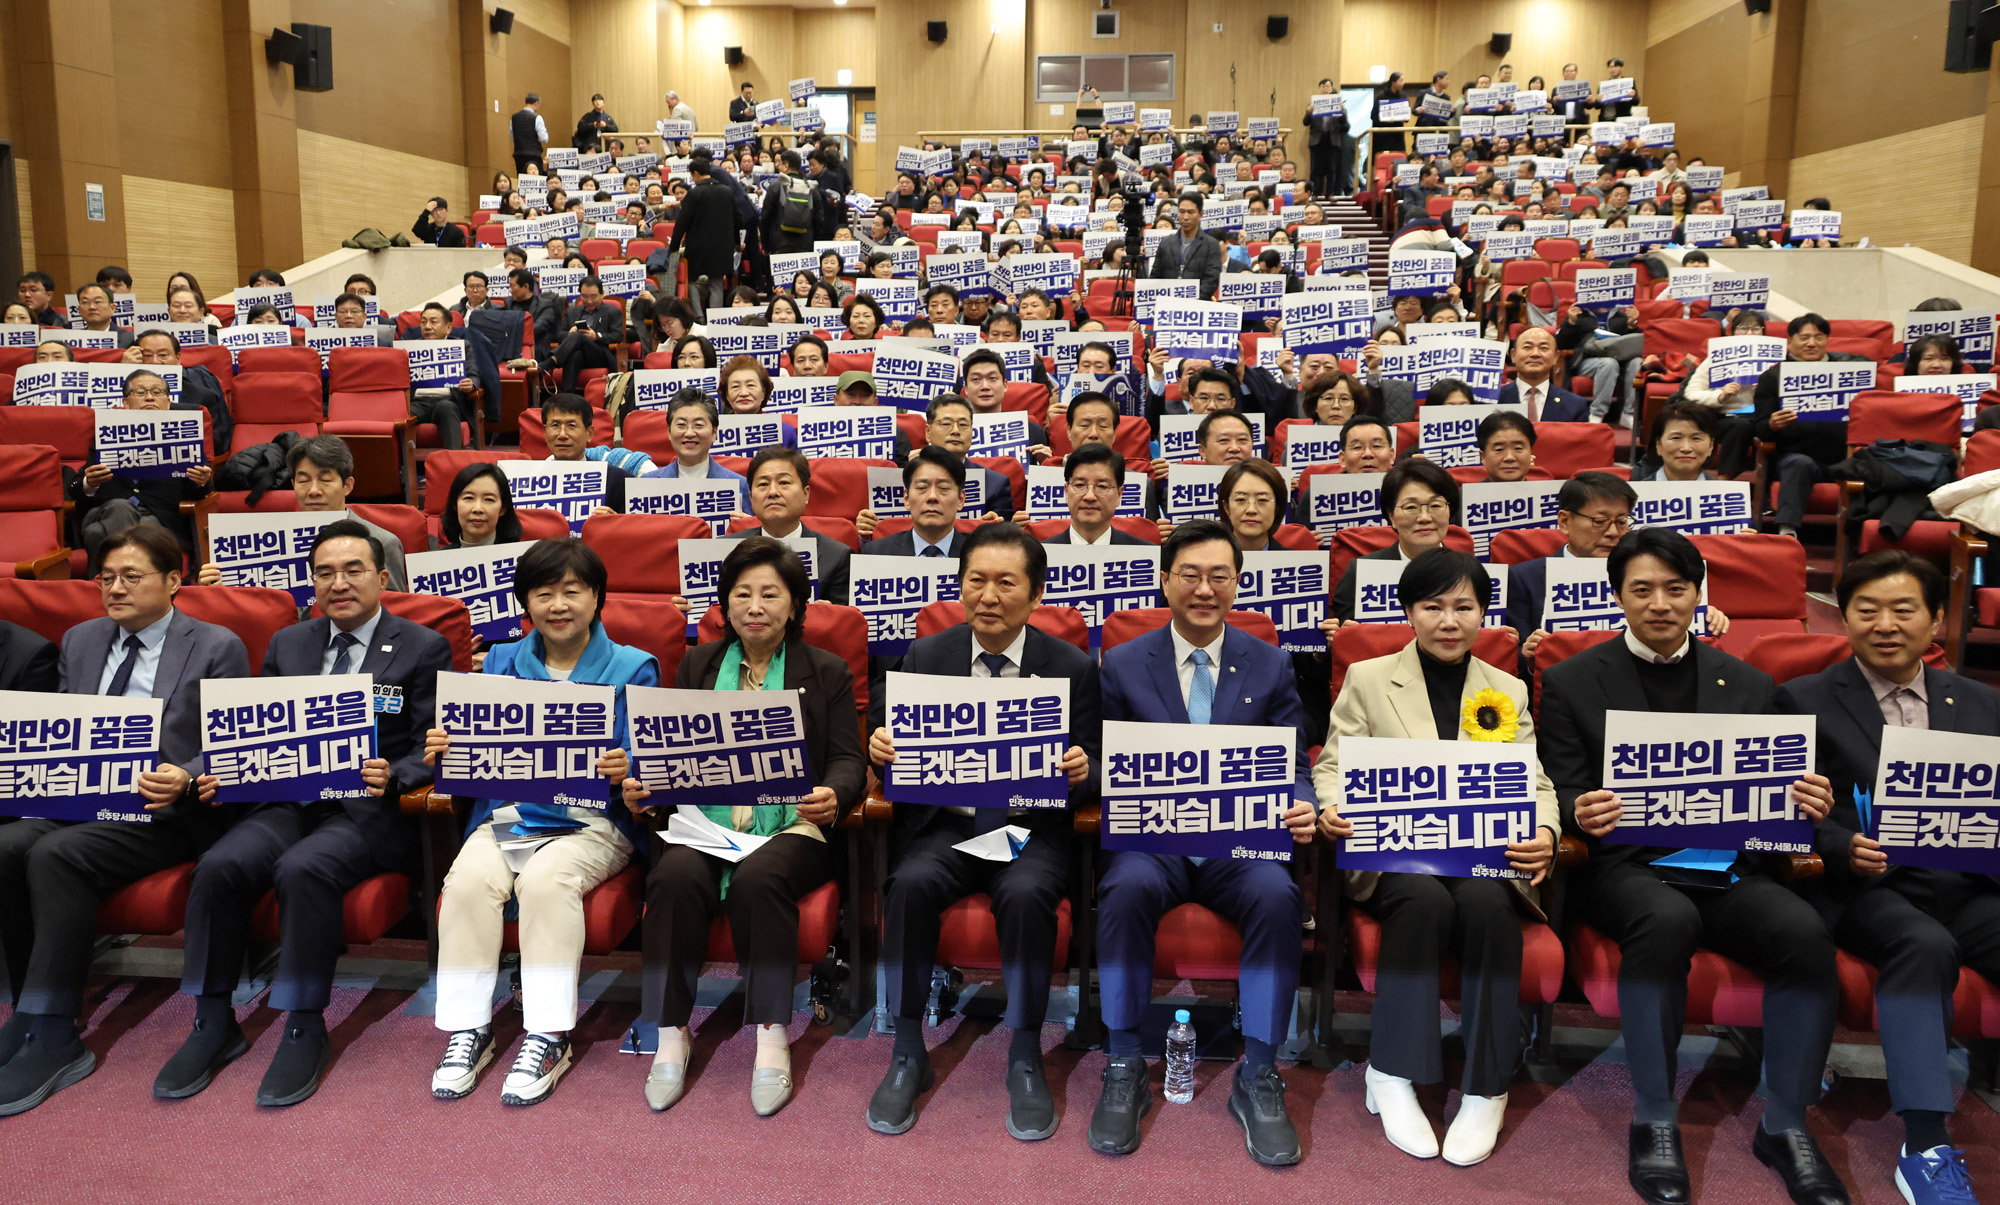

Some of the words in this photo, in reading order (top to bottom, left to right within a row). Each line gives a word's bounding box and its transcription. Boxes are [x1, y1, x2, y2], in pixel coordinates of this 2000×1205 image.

[772, 261, 799, 272] 천만의
[801, 257, 818, 267] 꿈을
[901, 251, 918, 260] 꿈을
[1391, 259, 1427, 272] 천만의
[1431, 257, 1453, 270] 꿈을
[601, 272, 626, 283] 천만의
[627, 268, 645, 278] 꿈을
[929, 263, 961, 278] 천만의
[963, 259, 986, 273] 꿈을
[1012, 263, 1046, 278] 천만의
[1049, 259, 1071, 273] 꿈을
[894, 286, 915, 299] 꿈을
[1013, 273, 1072, 294] 듣겠습니다!
[1221, 282, 1256, 297] 천만의
[1260, 281, 1284, 295] 꿈을
[1578, 276, 1610, 289] 천만의
[1613, 274, 1633, 285] 꿈을
[1713, 281, 1746, 292] 천만의
[1748, 278, 1769, 289] 꿈을
[1157, 310, 1204, 327] 천만의
[1208, 311, 1239, 327] 꿈을
[1285, 303, 1333, 326] 천만의
[1337, 299, 1370, 317] 꿈을
[1285, 320, 1371, 347] 듣겠습니다!
[1960, 316, 1992, 334] 꿈을
[10, 332, 36, 345] 꿈을
[178, 330, 206, 344] 꿈을
[265, 331, 288, 344] 꿈을
[751, 334, 779, 350] 꿈을
[1155, 331, 1238, 350] 듣겠습니다!
[408, 350, 434, 364] 만의
[437, 346, 462, 361] 꿈을
[1004, 349, 1031, 365] 꿈을
[1419, 348, 1465, 368] 천만의
[1470, 348, 1501, 366] 꿈을
[1711, 346, 1754, 364] 천만의
[1757, 344, 1783, 358] 꿈을
[876, 357, 924, 377] 천만의
[926, 359, 956, 380] 꿈을
[16, 372, 56, 396] 천만의
[637, 380, 684, 401] 천만의
[1783, 373, 1832, 392] 천만의
[1838, 370, 1872, 388] 꿈을
[1957, 381, 1990, 399] 꿈을
[100, 424, 156, 444] 천만의
[161, 420, 199, 440] 꿈을
[745, 423, 779, 445] 꿈을
[801, 420, 851, 442] 천만의
[857, 415, 893, 436] 꿈을
[990, 420, 1025, 443] 꿈을
[100, 444, 201, 470] 듣겠습니다!
[563, 472, 602, 494] 꿈을
[629, 494, 690, 514] 천만의
[696, 488, 735, 512] 꿈을
[1700, 490, 1746, 518] 꿈을
[1467, 498, 1535, 527] 천만의
[214, 530, 286, 563] 천만의
[413, 563, 487, 596] 천만의
[1046, 563, 1095, 594] 만의
[1104, 559, 1155, 590] 꿈을
[1271, 564, 1323, 596] 꿈을
[854, 575, 929, 606] 천만의
[207, 701, 295, 744] 천만의
[304, 690, 367, 731] 꿈을
[441, 702, 534, 737] 천만의
[543, 703, 607, 736] 꿈을
[633, 713, 725, 750] 천만의
[731, 705, 796, 741] 꿈을
[891, 701, 986, 739] 천만의
[996, 695, 1062, 733] 꿈을
[0, 718, 82, 753] 천만의
[90, 715, 153, 750] 꿈을
[210, 734, 370, 787] 듣겠습니다!
[441, 747, 607, 782] 듣겠습니다!
[890, 742, 1063, 786] 듣겠습니다!
[1108, 750, 1209, 788] 천만의
[1219, 744, 1287, 783] 꿈을
[1612, 740, 1723, 779] 천만의
[1734, 733, 1807, 774] 꿈을
[638, 748, 805, 791] 듣겠습니다!
[1885, 761, 2000, 800] 천만의
[1344, 765, 1446, 804] 천만의
[1457, 761, 1528, 800] 꿈을
[320, 790, 344, 800] 민주당
[553, 795, 577, 806] 민주당
[577, 797, 607, 810] 서울시당
[757, 795, 781, 805] 민주당
[1009, 797, 1033, 807] 민주당
[1033, 799, 1066, 808] 서울시당
[1614, 784, 1808, 827] 듣겠습니다
[97, 812, 121, 821] 민주당
[121, 813, 152, 823] 서울시당
[1107, 793, 1289, 834] 듣겠습니다!
[1344, 810, 1530, 853] 듣겠습니다!
[1878, 809, 2000, 849] 듣겠습
[1231, 848, 1257, 859] 민주당
[1257, 850, 1291, 861] 서울시당
[1744, 839, 1773, 851] 민주당
[1773, 842, 1811, 853] 서울시당
[1471, 866, 1498, 877] 민주당
[1498, 867, 1532, 879] 서울시당
